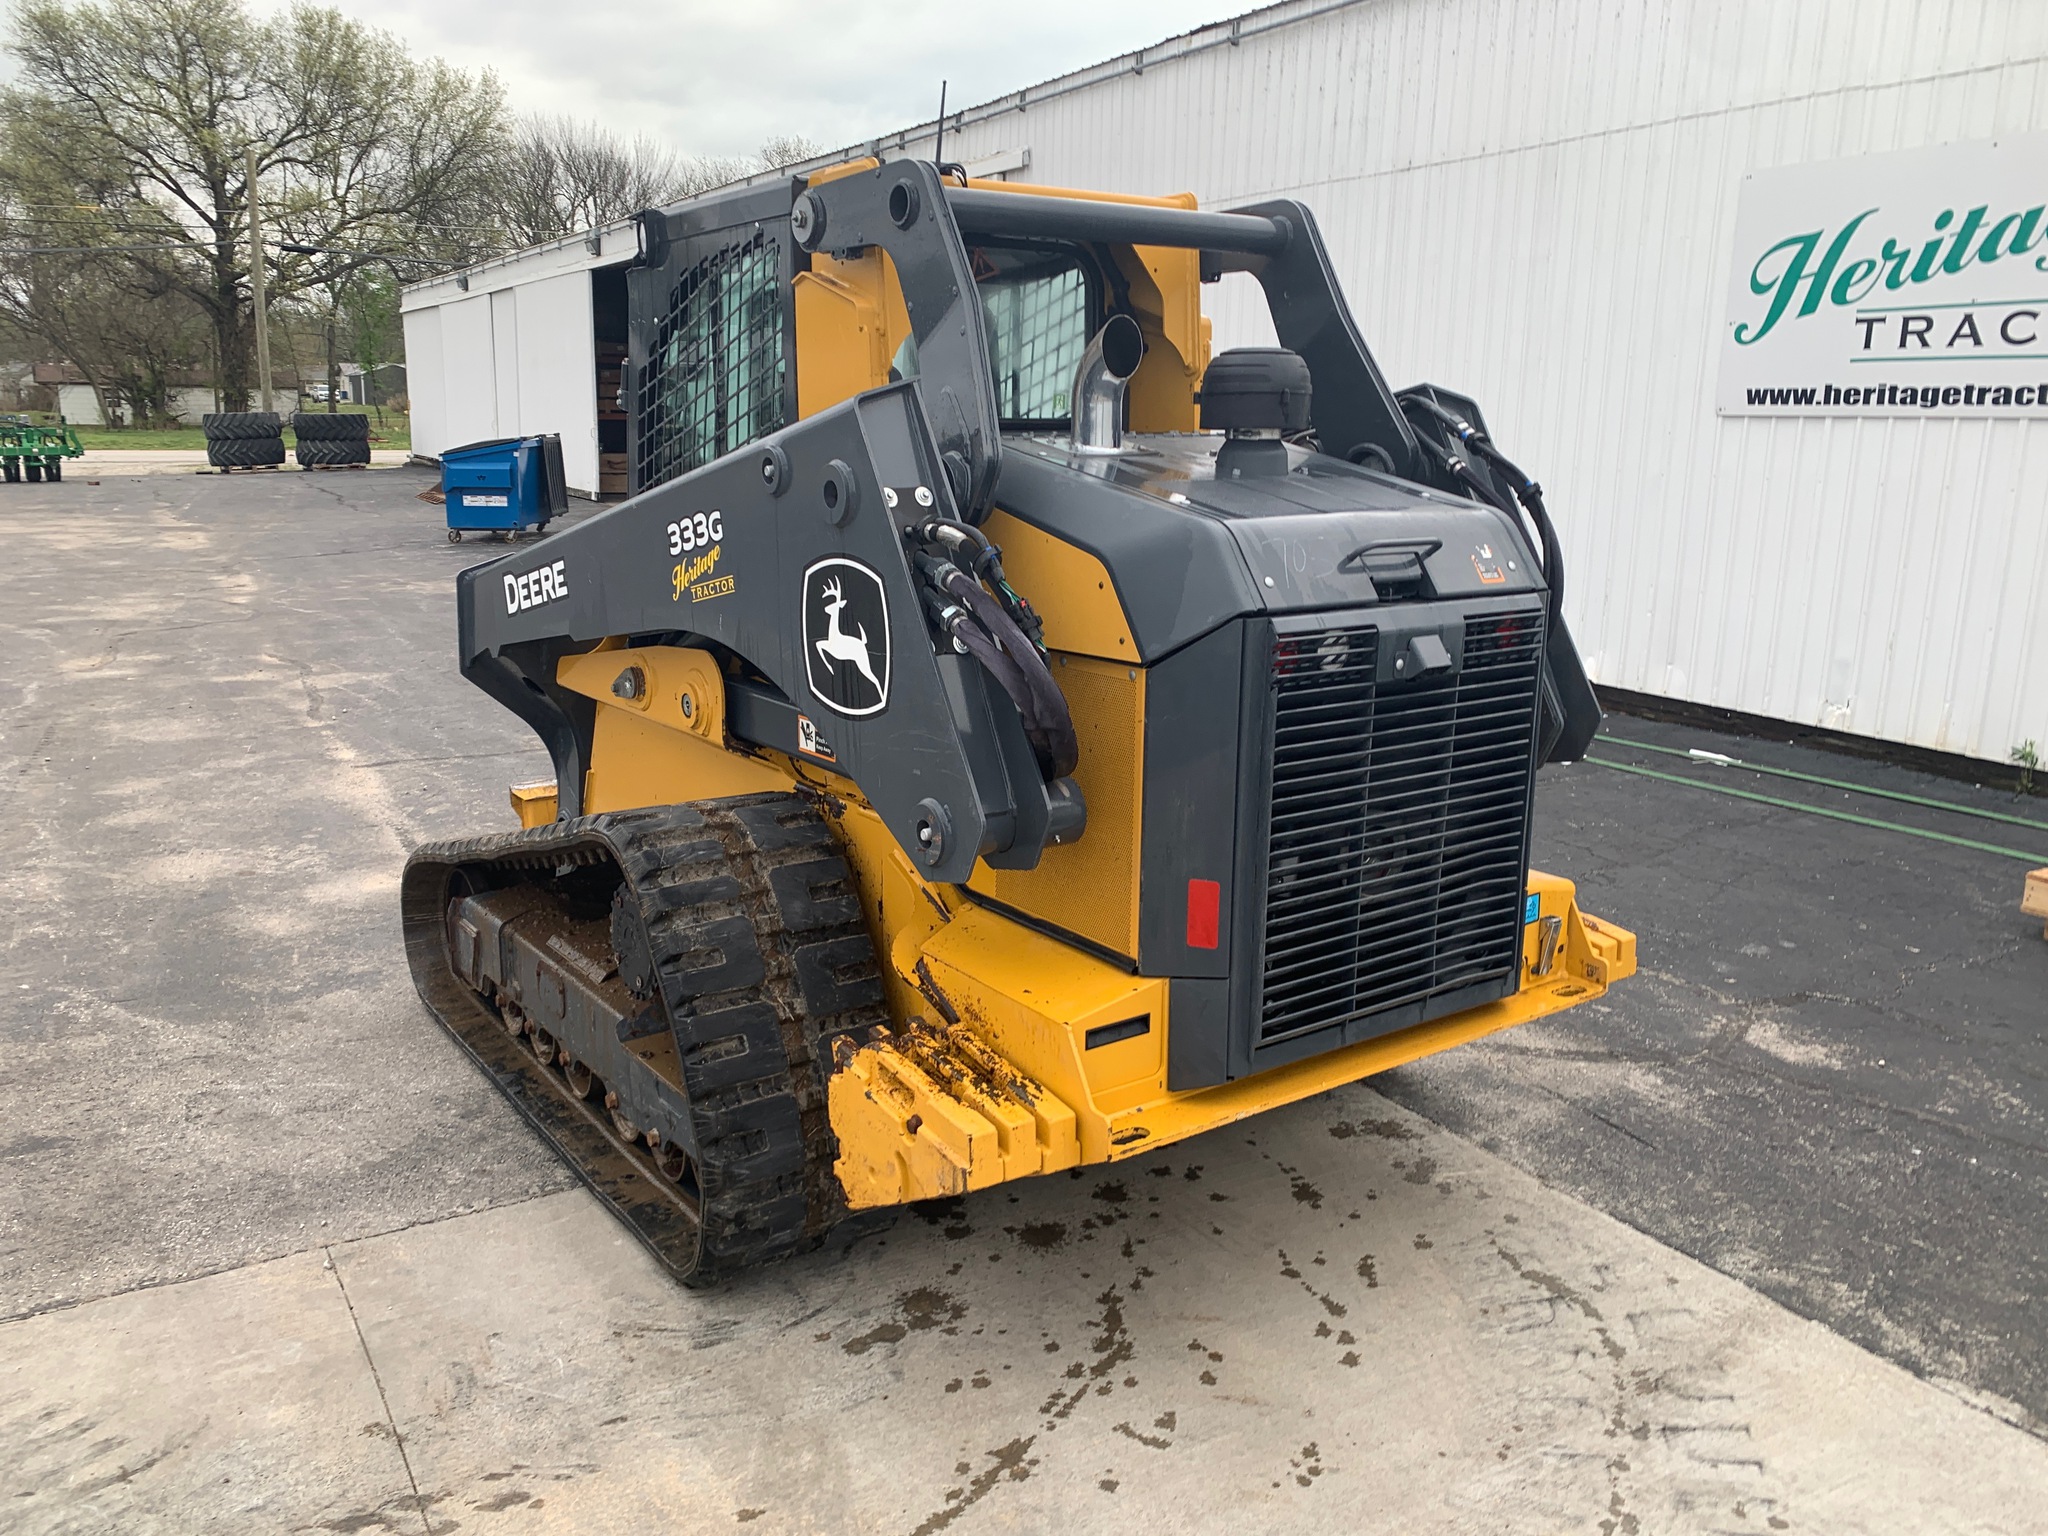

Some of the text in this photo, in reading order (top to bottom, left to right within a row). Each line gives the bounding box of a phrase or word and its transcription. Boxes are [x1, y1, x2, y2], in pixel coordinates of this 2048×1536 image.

[1734, 203, 2048, 345] Herita
[1855, 310, 2041, 349] TRAC
[1746, 383, 2048, 408] www.heritagetract
[667, 511, 724, 556] 333G
[503, 560, 568, 615] DEERE
[672, 545, 720, 601] Heritage
[691, 579, 735, 599] TRACTOR
